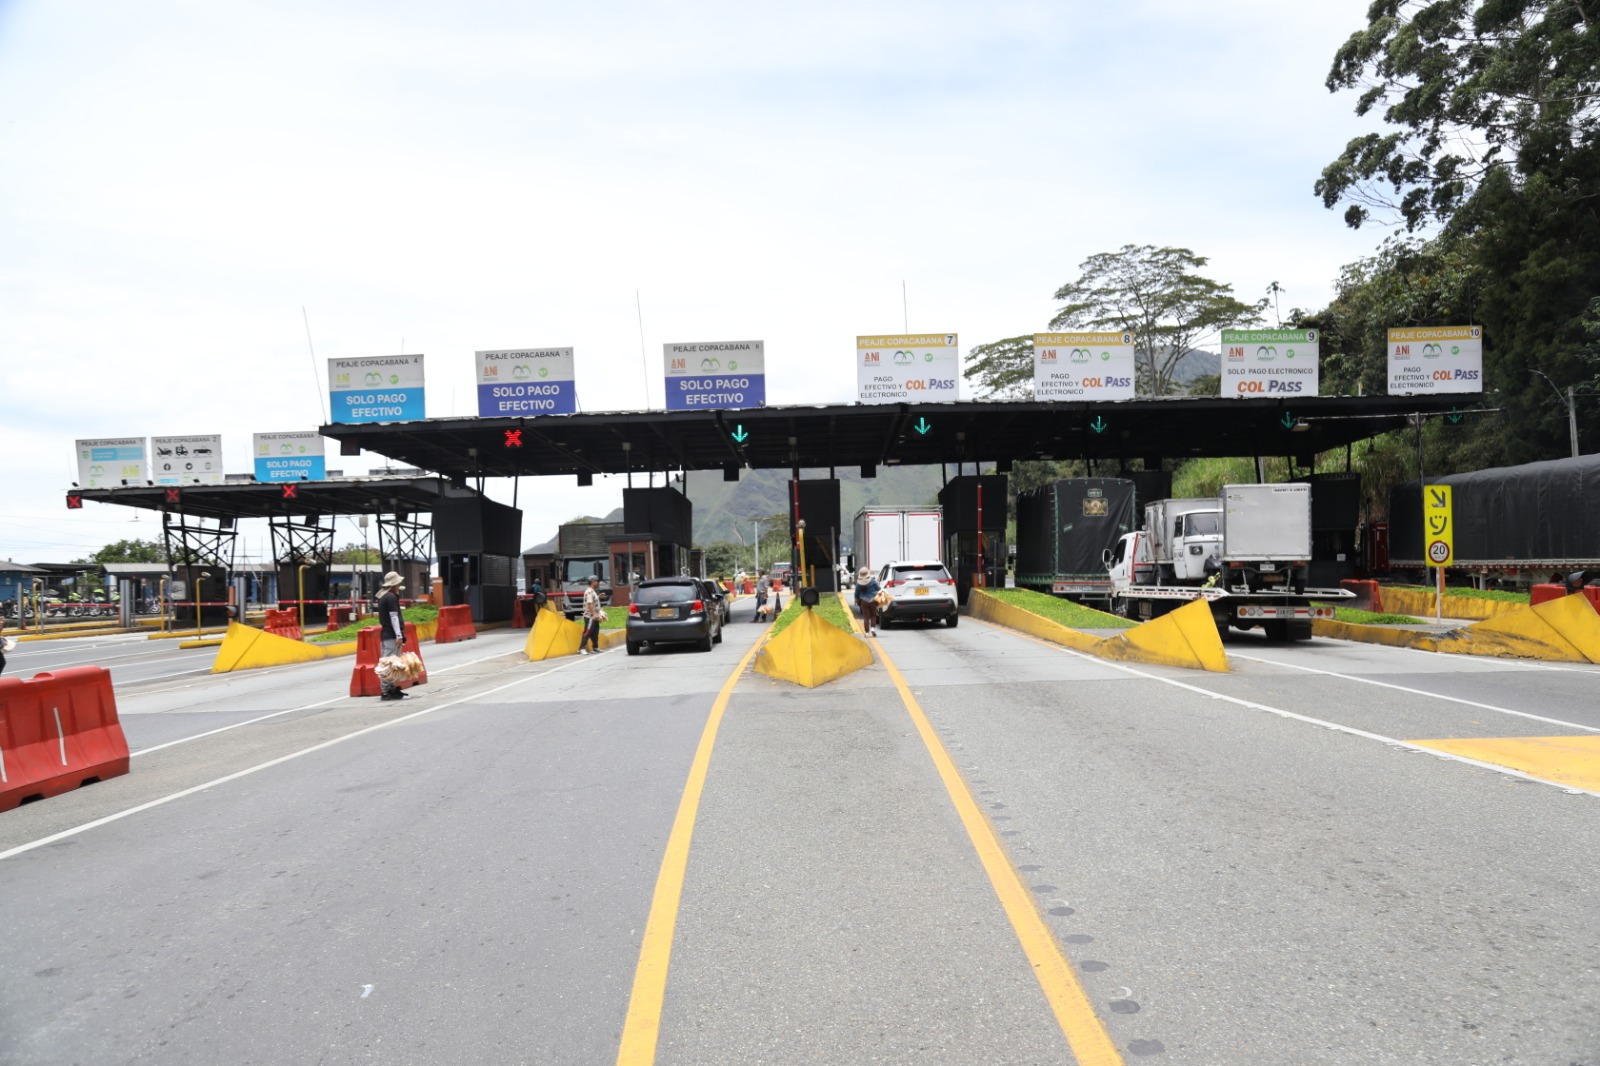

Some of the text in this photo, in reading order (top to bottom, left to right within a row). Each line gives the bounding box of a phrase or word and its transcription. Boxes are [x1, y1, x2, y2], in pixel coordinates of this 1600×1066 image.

[1224, 332, 1314, 341] PEAJE COPACABANA 9
[1416, 330, 1468, 338] COPACABANA
[1470, 328, 1479, 336] 10
[888, 337, 943, 345] COPACABANA
[947, 336, 954, 344] 7
[1036, 334, 1130, 344] PEAJE COPACABANA 8
[699, 344, 750, 352] COPACABANA
[486, 352, 508, 360] PEAJE
[510, 350, 560, 359] COPACABANA
[336, 360, 358, 368] PEAJE
[361, 358, 409, 367] COPACABANA
[1433, 369, 1478, 380] COL PASS
[680, 379, 749, 390] SOLO PAGO
[906, 378, 955, 390] COL PASS
[1082, 376, 1131, 388] COL PASS
[1237, 380, 1302, 393] COL PASS
[493, 385, 560, 397] SOLO PAGO
[346, 393, 406, 405] SOLO PAGO
[686, 393, 744, 405] EFECTIVO
[499, 400, 555, 411] EFECTIVO
[352, 407, 402, 417] EFECTIVO
[270, 469, 309, 478] EFECTIVO
[1433, 545, 1445, 555] 20
